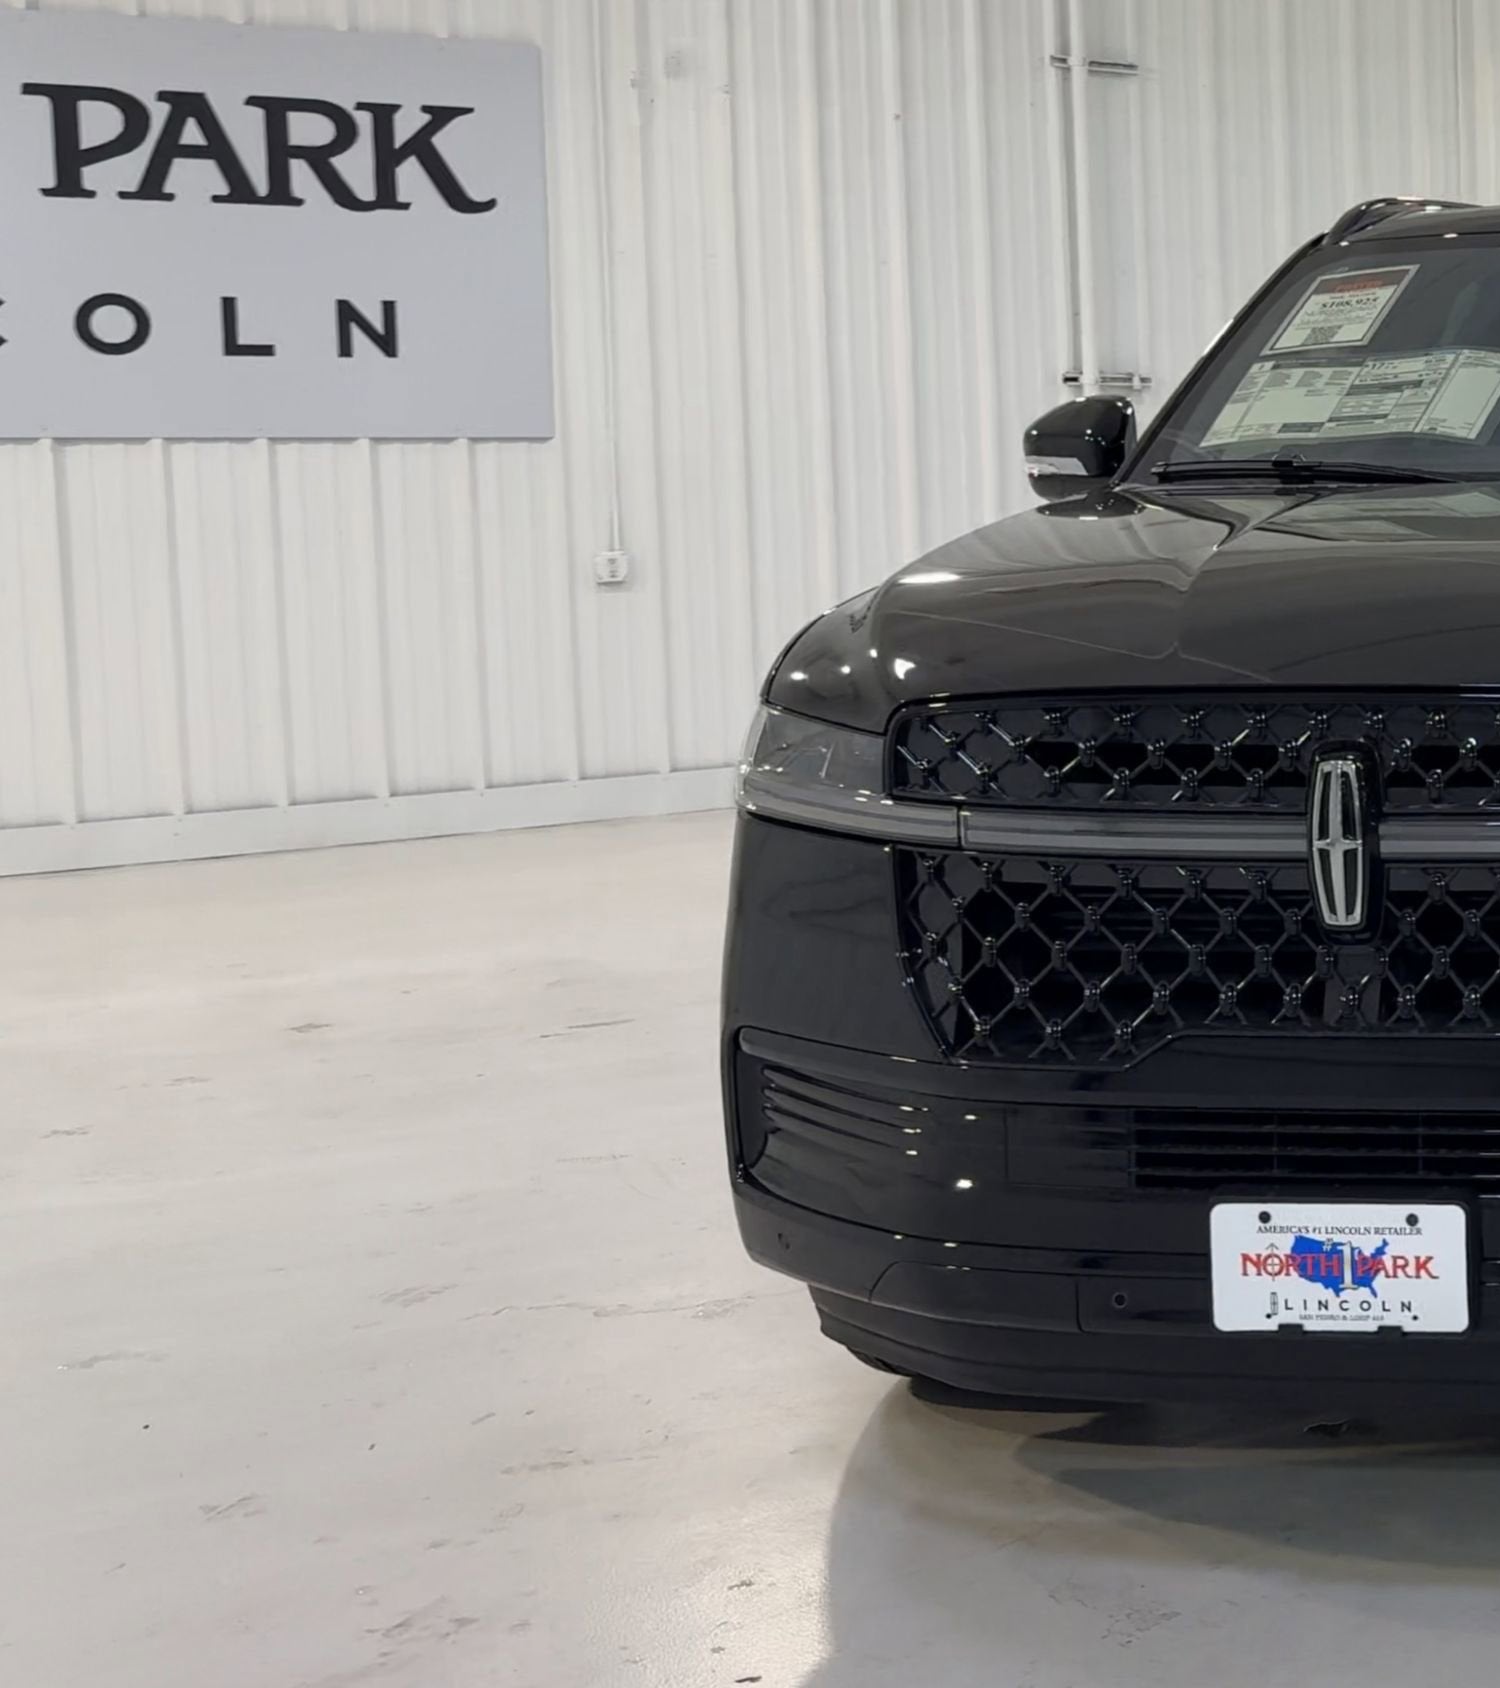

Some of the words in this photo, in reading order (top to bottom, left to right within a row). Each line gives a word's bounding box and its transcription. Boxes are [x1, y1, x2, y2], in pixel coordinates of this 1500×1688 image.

[21, 82, 497, 214] PARK
[0, 293, 399, 359] OLN
[1256, 1225, 1310, 1235] AMERICA'S
[1312, 1226, 1322, 1235] #1
[1324, 1226, 1371, 1236] LINCOLN
[1374, 1226, 1423, 1236] RETAILER
[1240, 1252, 1341, 1278] NORTH
[1356, 1253, 1439, 1279] PARK
[1284, 1299, 1413, 1312] LINCOLN
